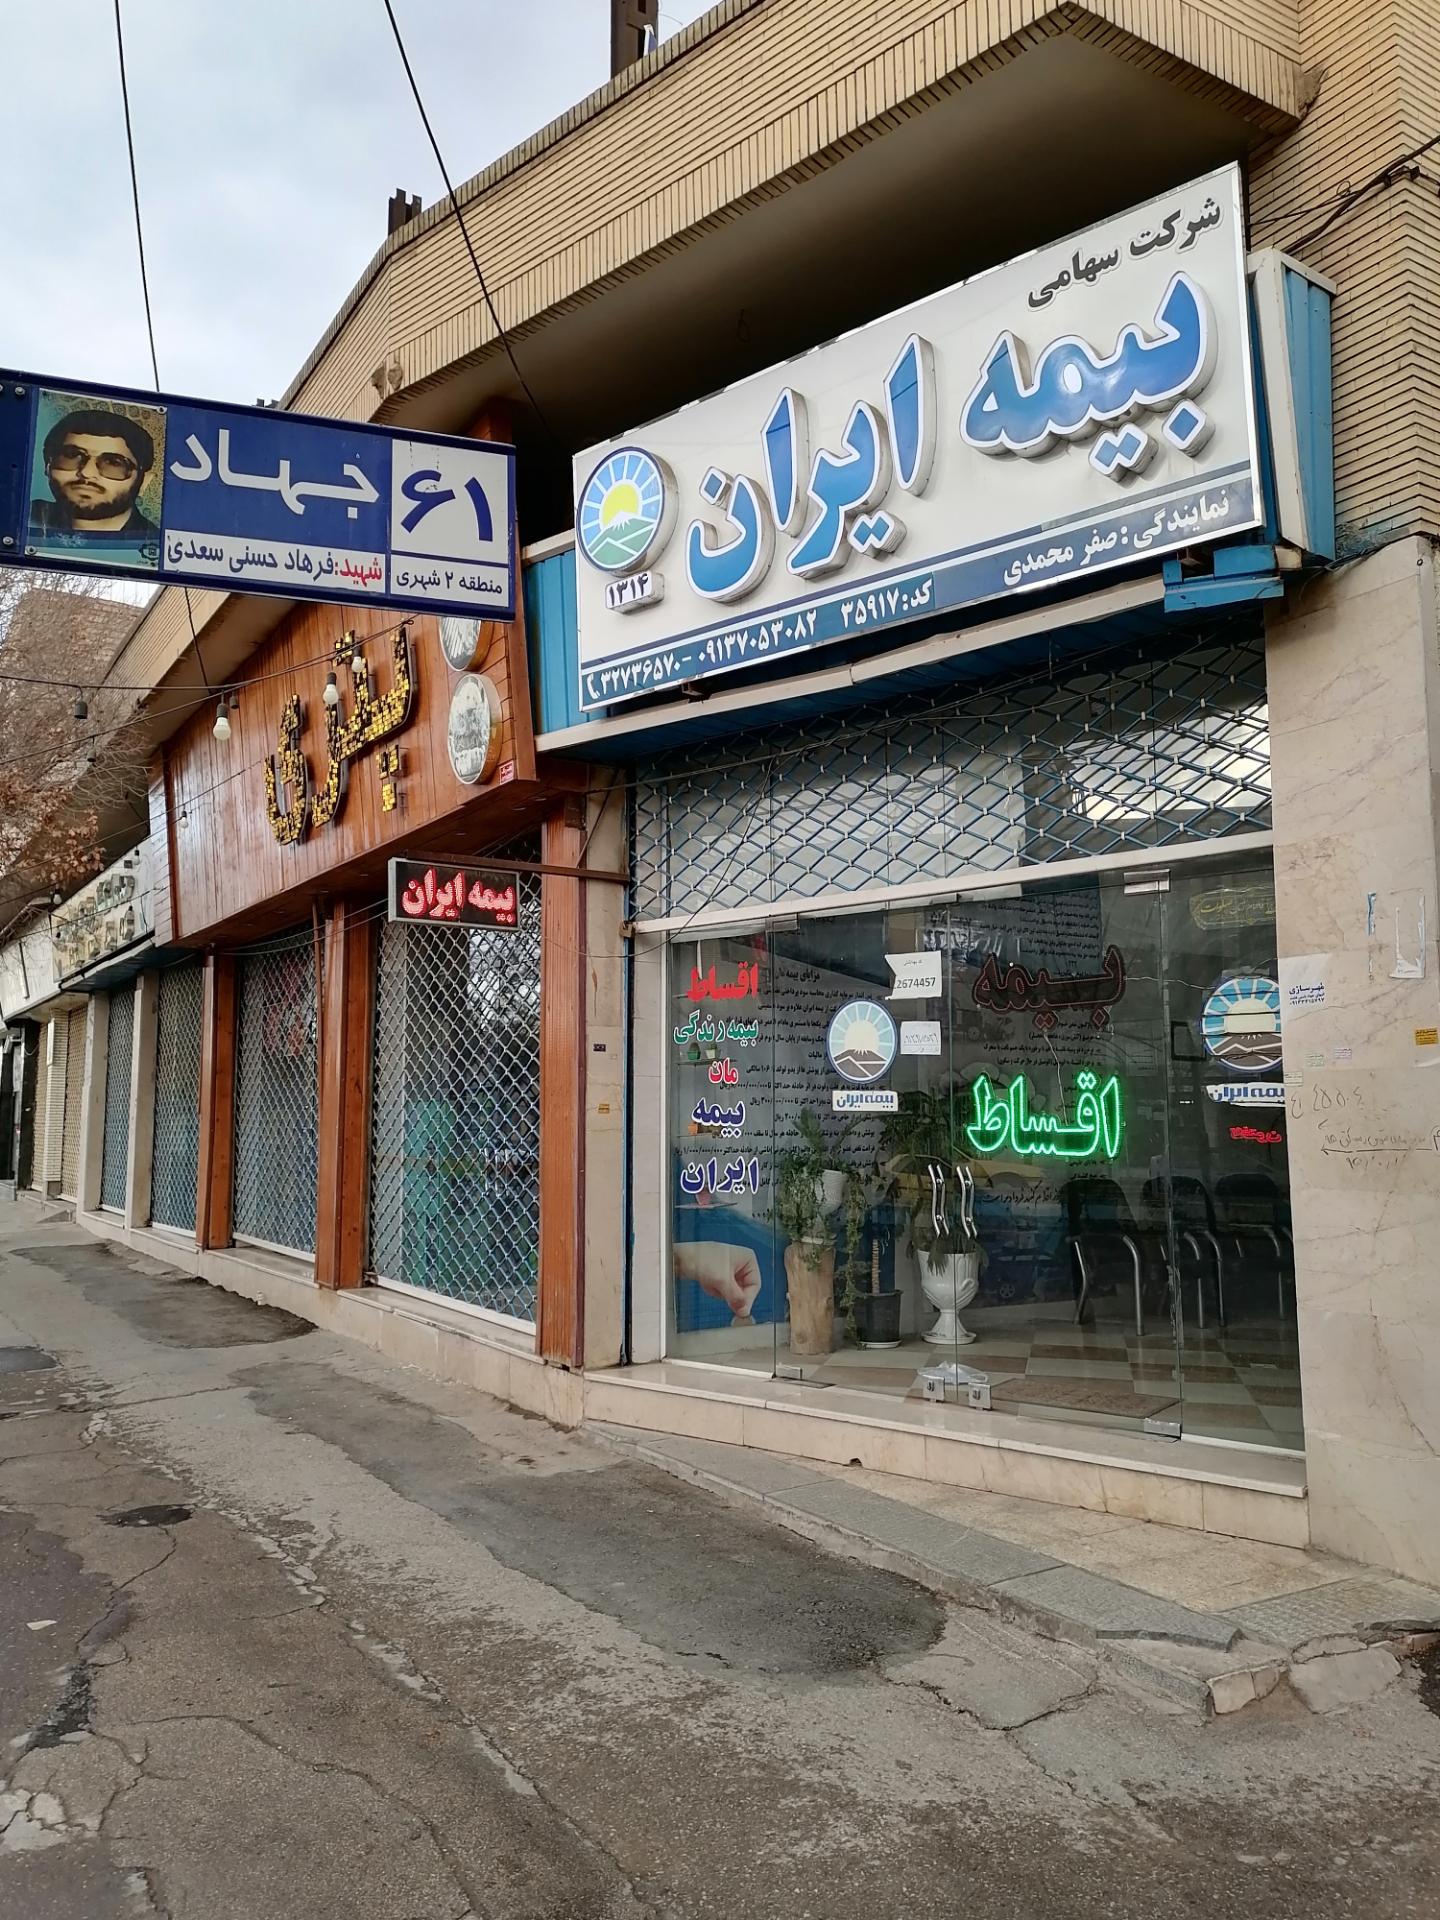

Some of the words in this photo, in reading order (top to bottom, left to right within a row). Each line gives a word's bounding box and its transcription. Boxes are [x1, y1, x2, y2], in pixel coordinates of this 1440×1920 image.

[1130, 197, 1221, 256] شرکت
[1028, 248, 1120, 308] سهامی
[959, 270, 1218, 482] بیمه
[169, 429, 380, 520] جهاد
[399, 469, 494, 543] ۶۱
[685, 331, 936, 602] ایران
[167, 541, 224, 565] سعدی
[229, 551, 277, 574] حسنی
[1003, 545, 1074, 587] محمدی
[1080, 527, 1118, 566] صفر
[284, 551, 335, 583] فرهاد
[395, 569, 441, 592] شهری
[446, 573, 455, 588] ۲
[458, 576, 503, 596] منطقه
[608, 573, 650, 607] ۱۳۱۴
[841, 587, 899, 629] ۳۵۹۱۷
[600, 652, 681, 695] ۳۲۷۳۶۵۷۰
[698, 609, 817, 663] ۰۹۱۳۷۰۵۳۰۸۲
[402, 867, 465, 919] ایران
[468, 880, 516, 923] بیمه
[685, 961, 759, 1002] اقساط
[893, 977, 936, 989] 2674457
[973, 944, 1127, 1029] بیمه
[727, 1020, 759, 1047] بیمه
[708, 1058, 739, 1085] مان
[692, 1097, 746, 1138] بیمه
[836, 1093, 865, 1108] ایران
[864, 1093, 895, 1108] بیمه
[966, 1071, 1121, 1159] اقساط
[680, 1155, 759, 1194] ایران
